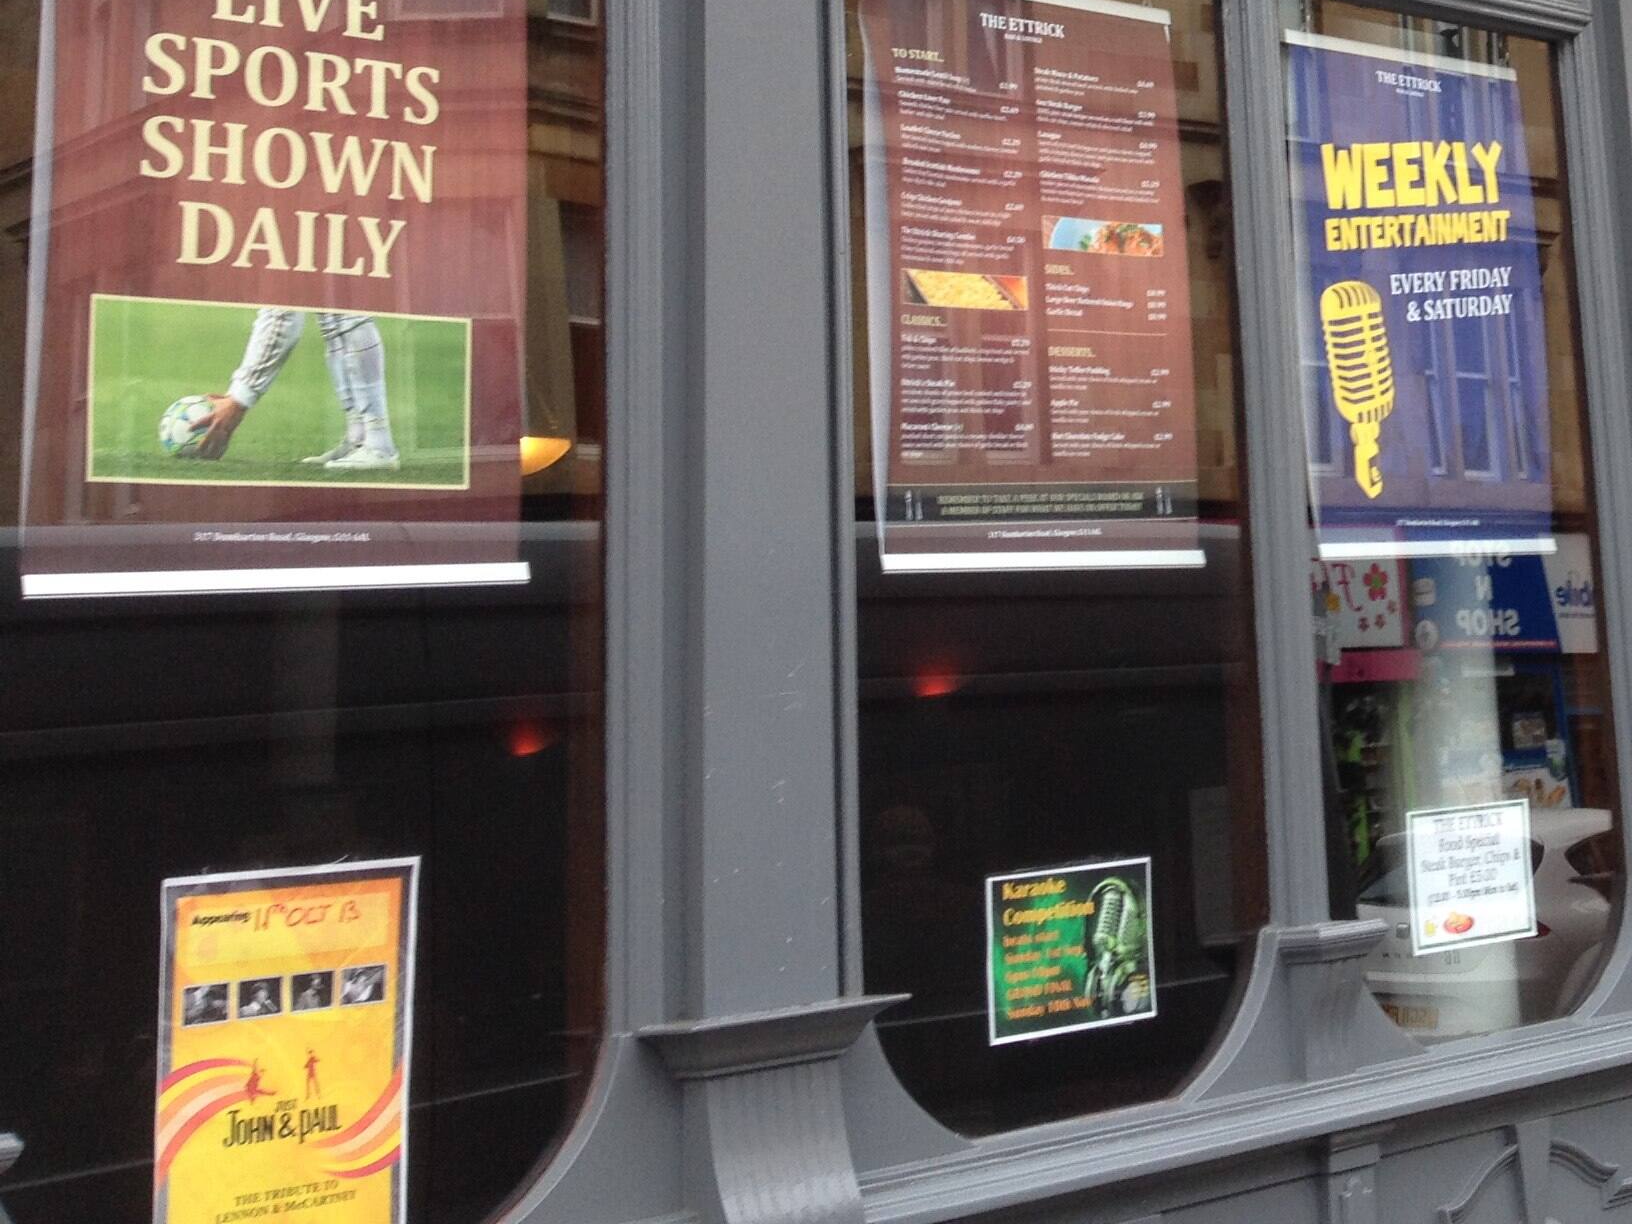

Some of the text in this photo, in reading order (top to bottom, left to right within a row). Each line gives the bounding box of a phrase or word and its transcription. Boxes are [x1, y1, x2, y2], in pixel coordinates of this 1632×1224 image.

[979, 12, 1007, 30] THE
[1008, 16, 1065, 39] ETTRICK
[141, 32, 442, 125] SPORTS
[138, 115, 438, 203] SHOWN
[1320, 140, 1503, 210] WEEKLY
[176, 200, 406, 279] DAILY
[1324, 210, 1512, 251] ENTERTAINMENT
[1390, 266, 1513, 296] EVERY FRIDAY
[1406, 294, 1513, 323] & SATURDAY
[1002, 877, 1067, 900] Karaoke
[191, 911, 250, 926] Appearing
[1003, 900, 1096, 926] Competition
[278, 1112, 296, 1139] &
[234, 1179, 339, 1207] THE TRIBUTE TO
